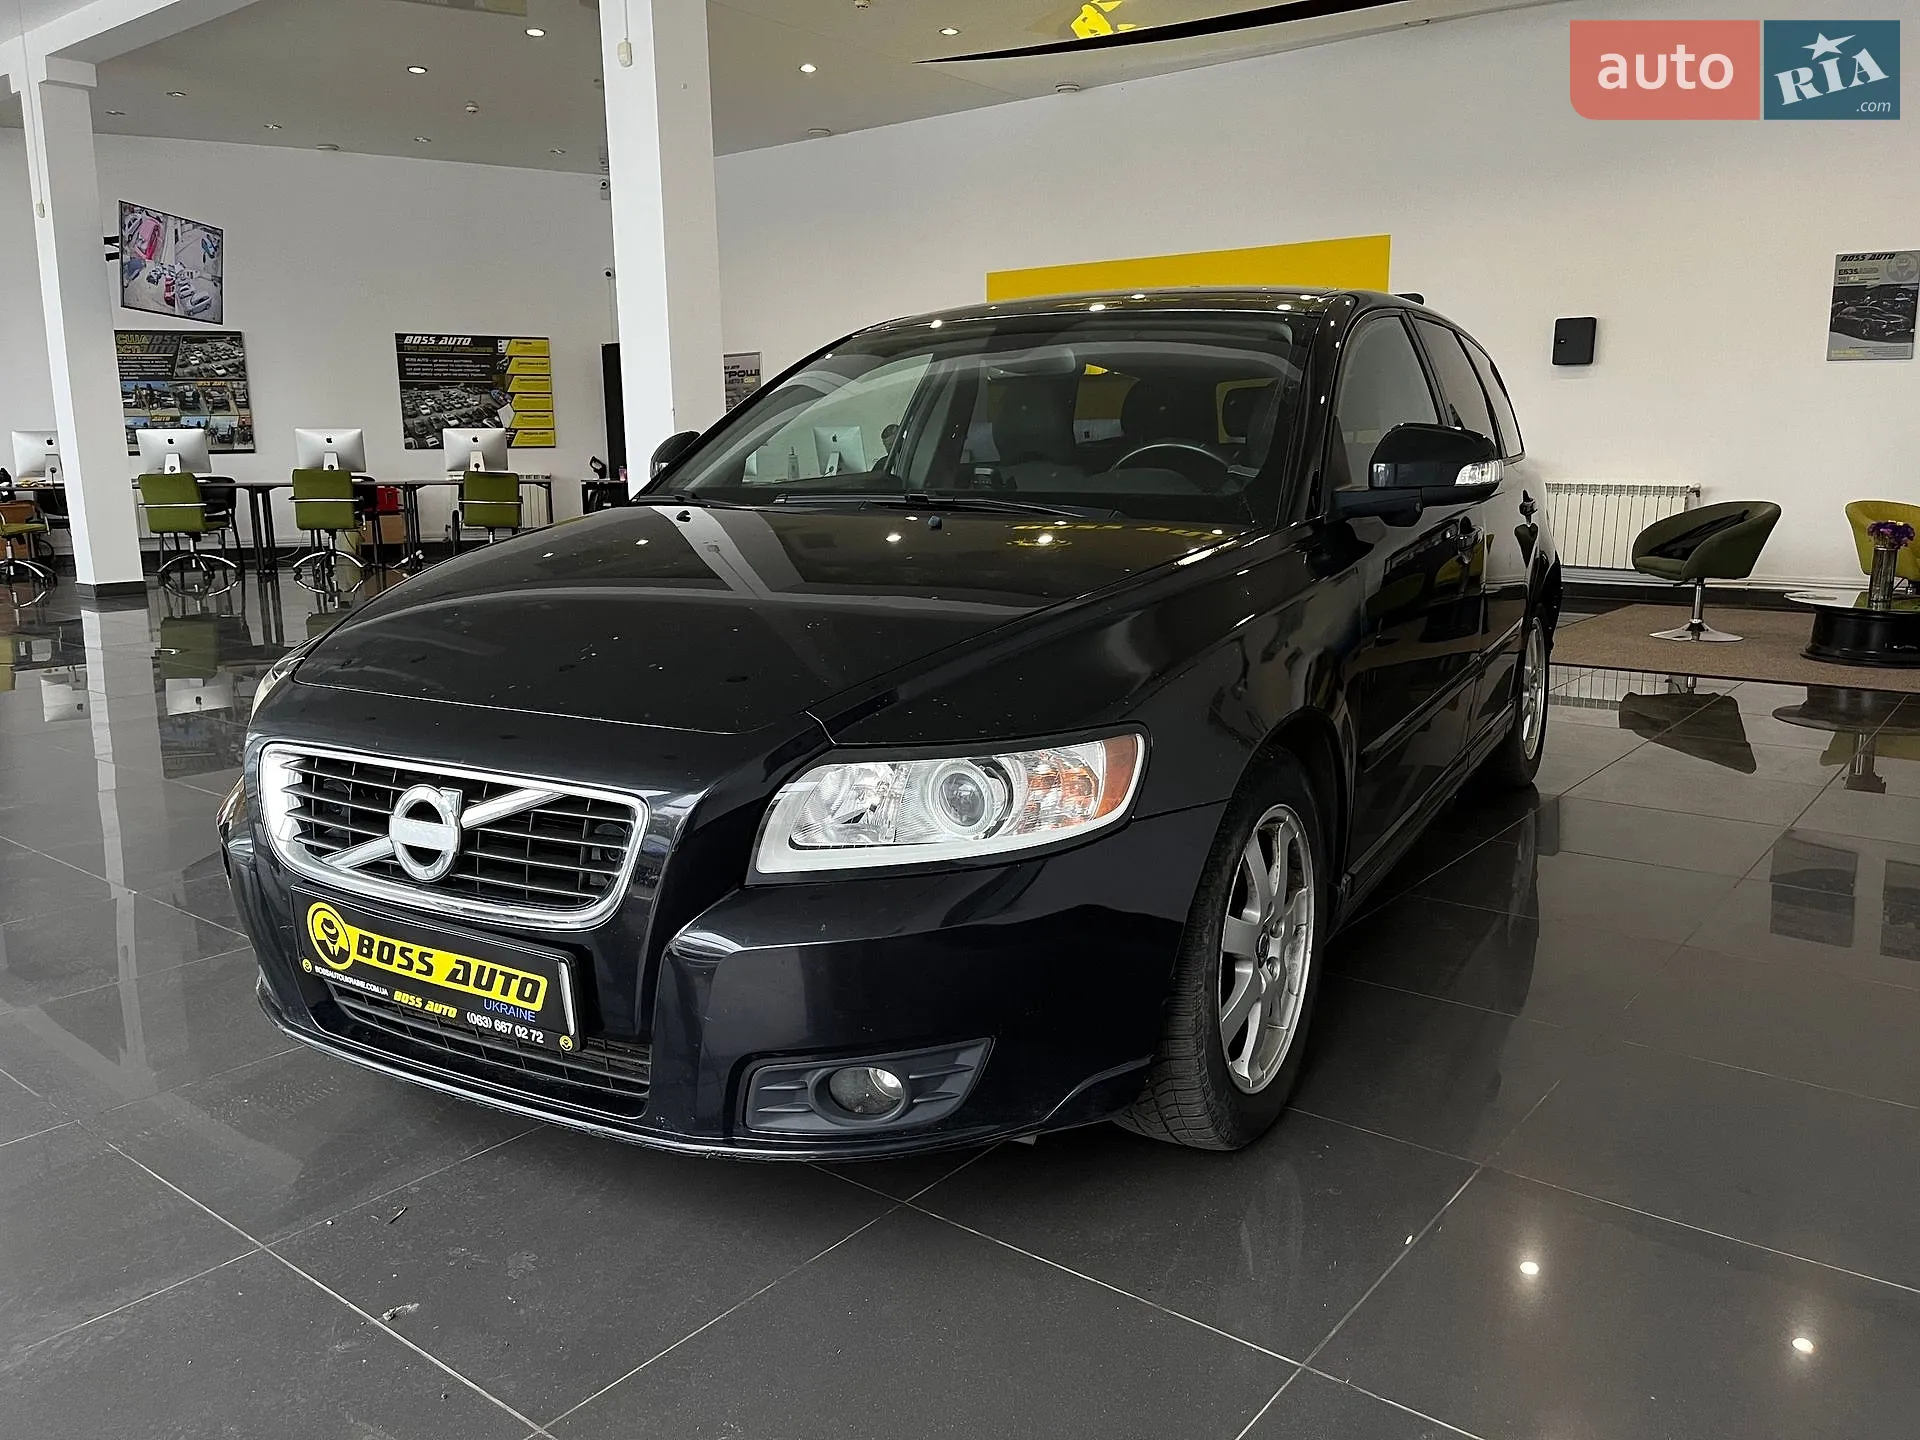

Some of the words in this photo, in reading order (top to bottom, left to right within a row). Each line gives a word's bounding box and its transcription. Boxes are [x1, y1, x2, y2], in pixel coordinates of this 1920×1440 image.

[1840, 254, 1866, 262] BOSS
[1867, 252, 1896, 261] AUTO
[404, 335, 436, 344] BOSS
[438, 336, 471, 346] AUTO
[356, 933, 434, 977] BOSS
[444, 958, 541, 1005] AUTO
[393, 990, 423, 1009] BOSS
[424, 1000, 458, 1019] AUTO
[483, 998, 537, 1023] UKRAINE
[466, 1011, 493, 1029] (063)
[494, 1019, 512, 1035] 667
[514, 1025, 529, 1040] 02
[529, 1030, 545, 1044] 72
